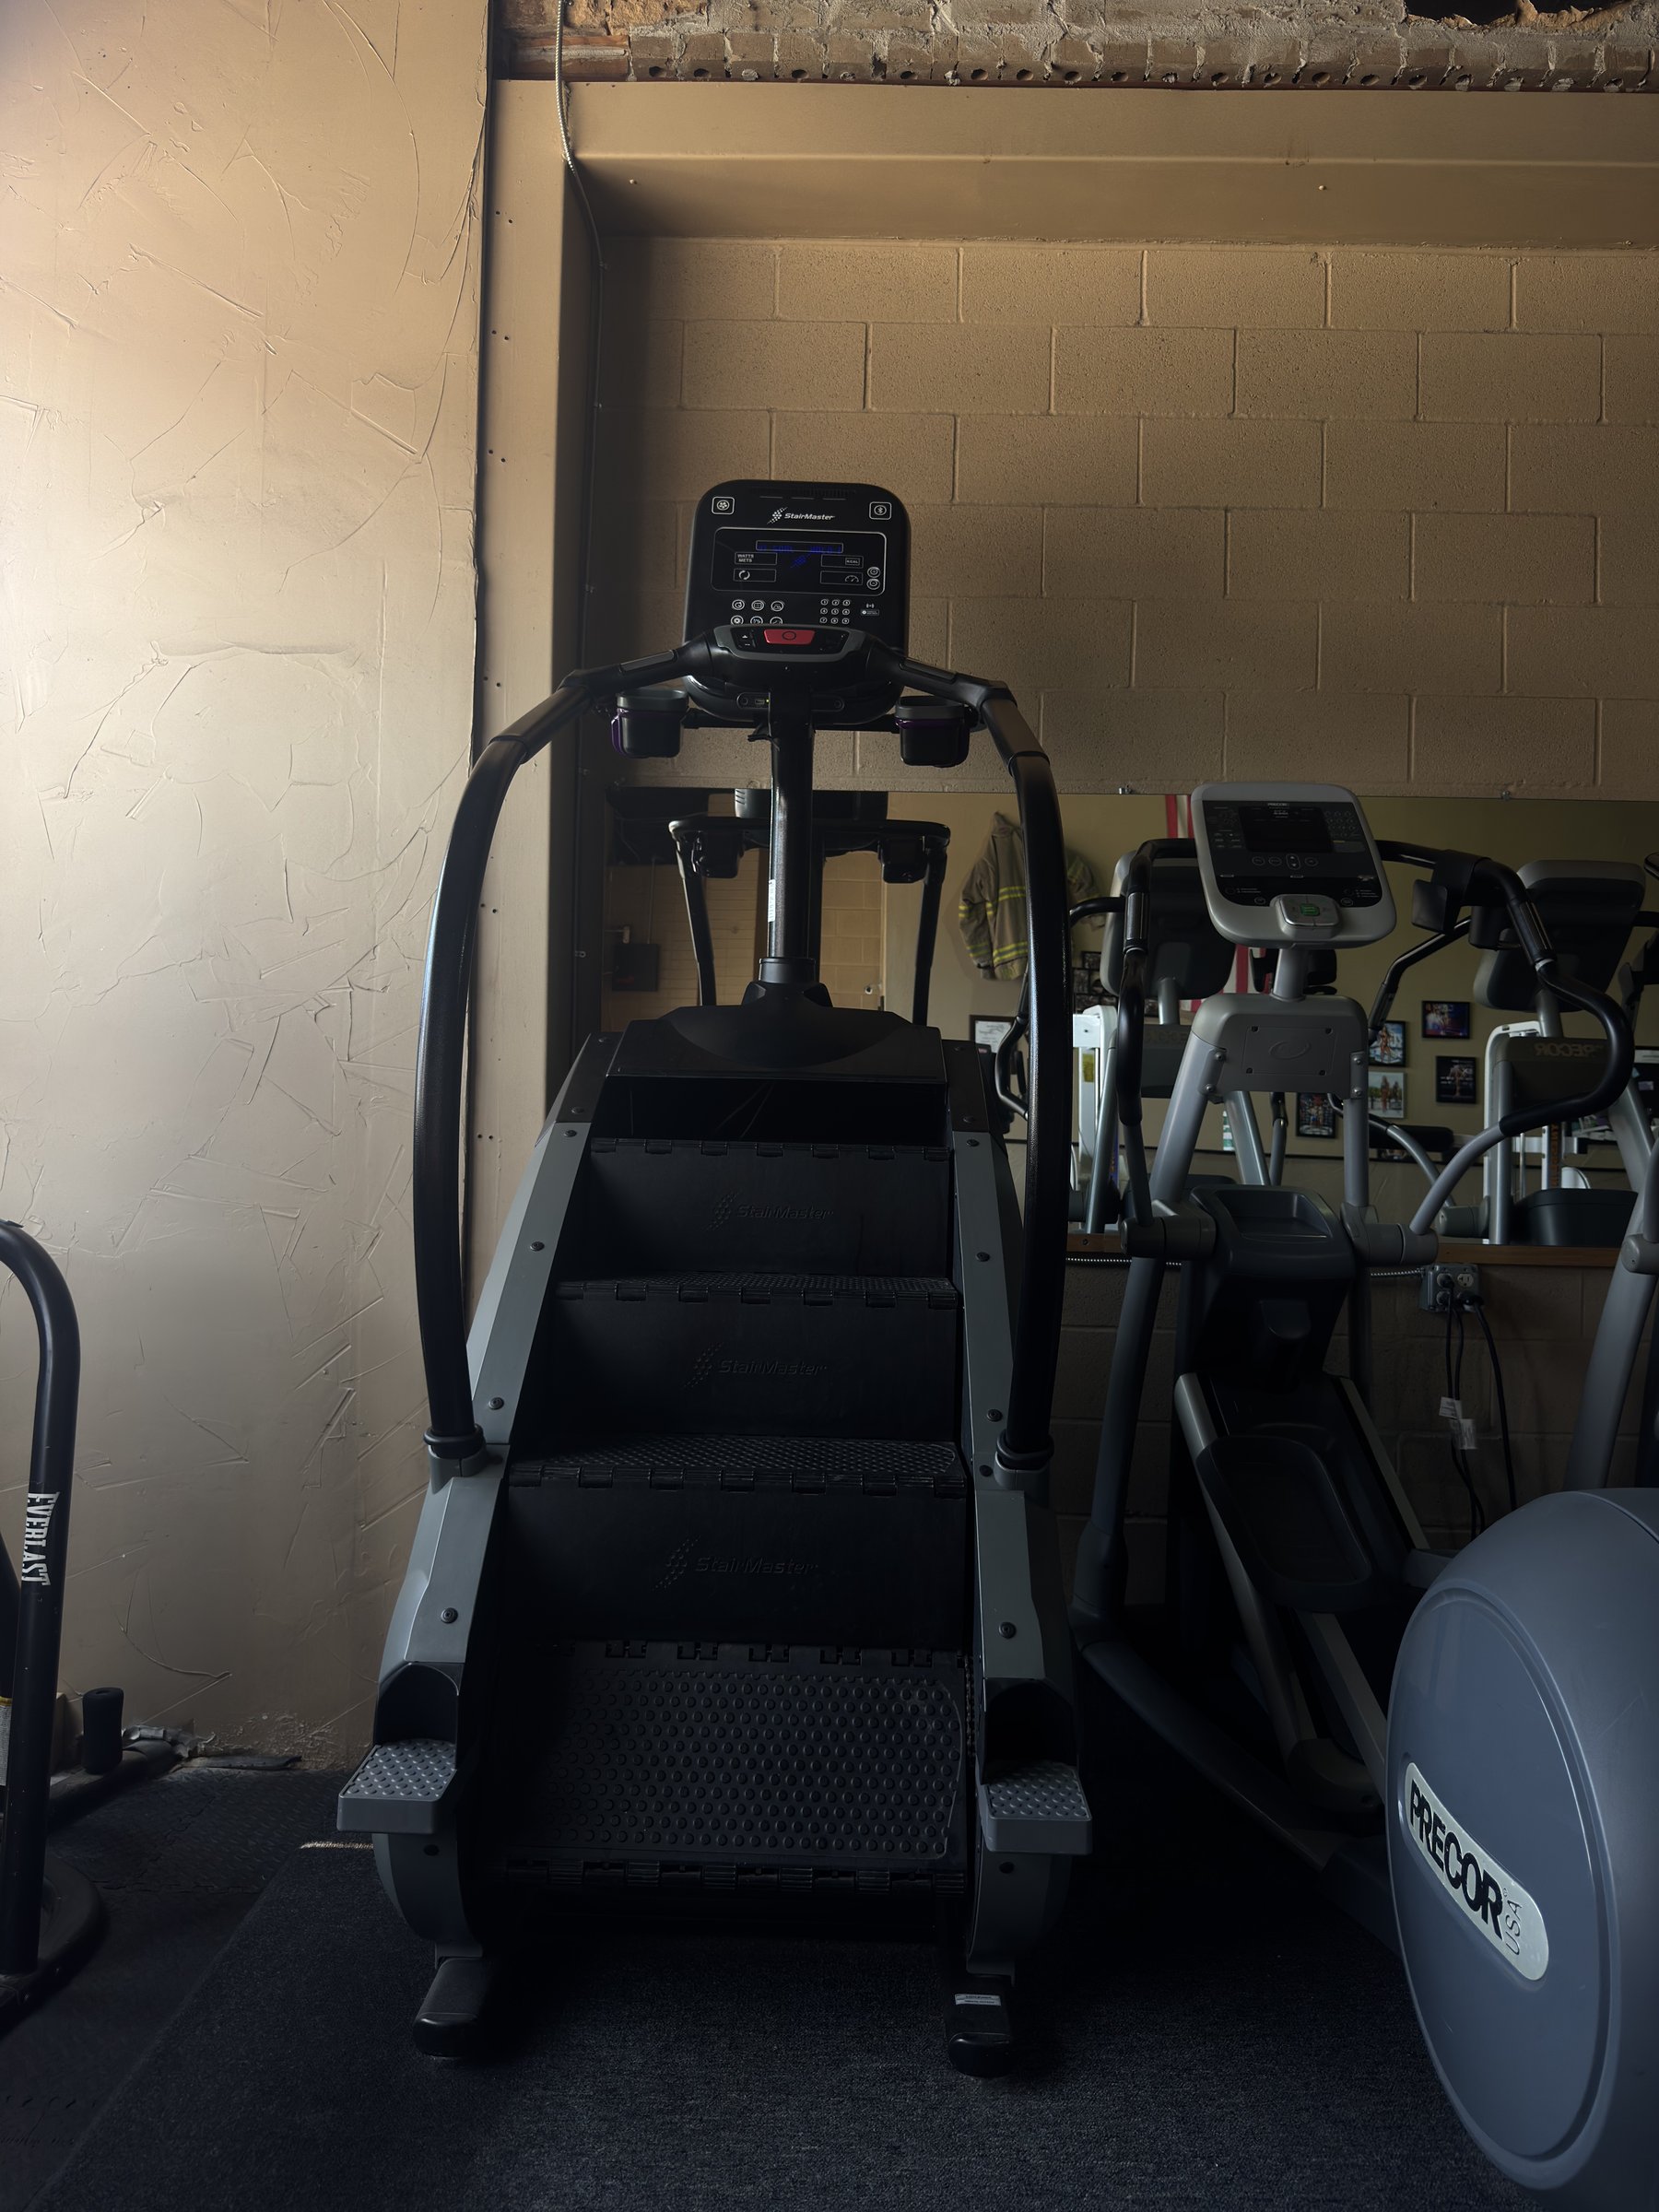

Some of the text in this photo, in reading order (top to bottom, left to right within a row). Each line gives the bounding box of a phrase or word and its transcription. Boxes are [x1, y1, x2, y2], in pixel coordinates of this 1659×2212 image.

[783, 512, 836, 521] StairMaster
[735, 1204, 831, 1220] StairMaster
[716, 1359, 824, 1375] StairMaster
[21, 1491, 60, 1586] EVERLAST
[695, 1556, 815, 1575] StairMaster
[1410, 1779, 1503, 1941] PRECOR
[1505, 1899, 1523, 1956] USA
